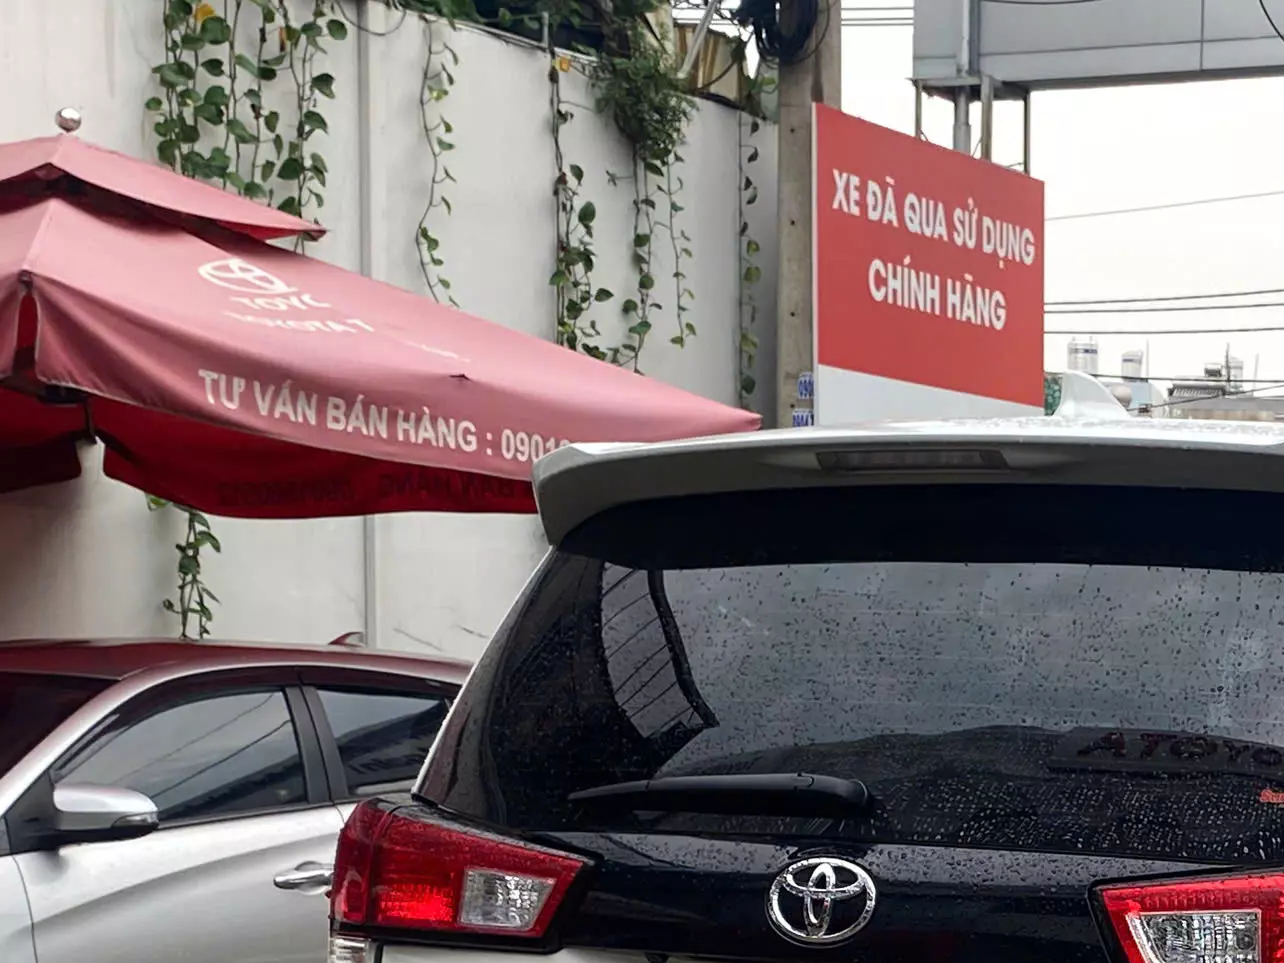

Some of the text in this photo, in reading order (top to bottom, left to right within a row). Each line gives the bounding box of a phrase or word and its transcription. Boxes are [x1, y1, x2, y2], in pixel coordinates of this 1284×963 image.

[832, 169, 1035, 269] XE ĐÃ QUA SỬ DỤNG
[868, 255, 940, 316] CHÍNH
[198, 369, 246, 410] TƯ
[327, 394, 388, 439] BÁN
[396, 406, 477, 453] HÀNG
[501, 428, 570, 462] 0901
